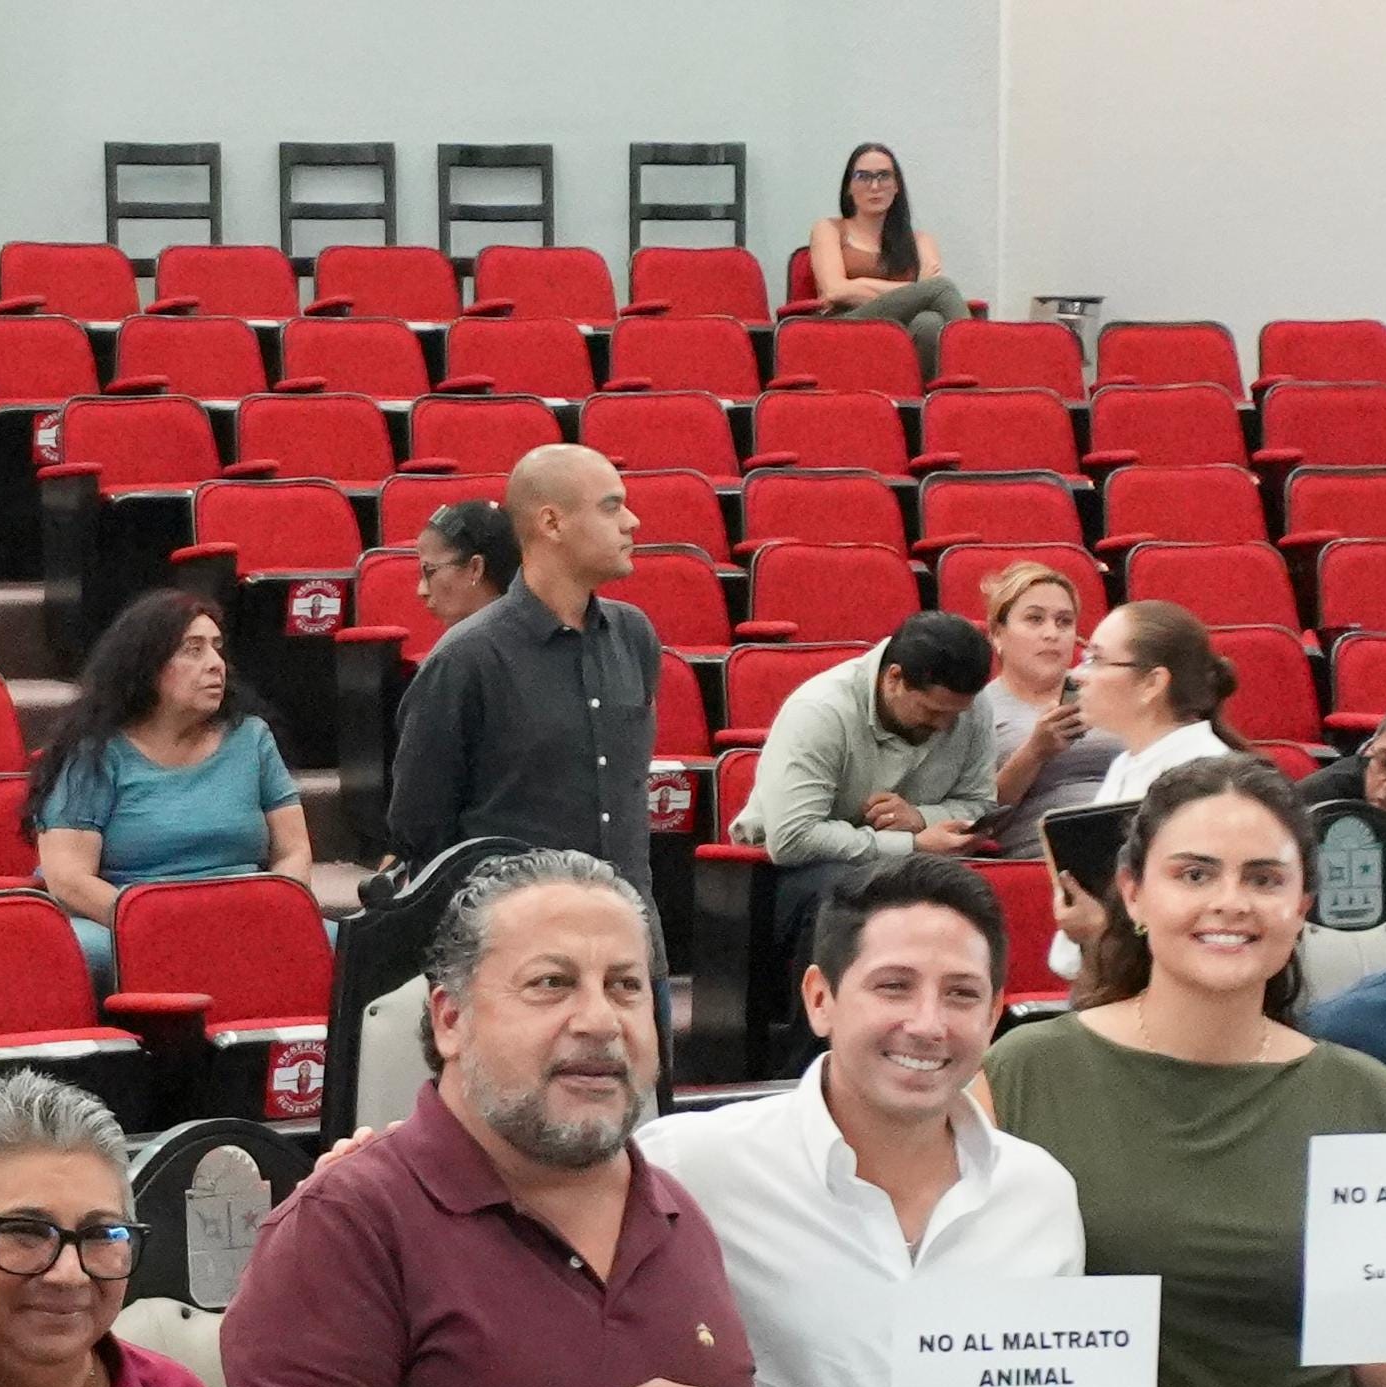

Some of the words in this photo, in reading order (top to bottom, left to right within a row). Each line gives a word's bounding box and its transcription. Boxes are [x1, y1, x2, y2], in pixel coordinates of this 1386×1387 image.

[277, 1041, 326, 1067] RESERVA
[1332, 1187, 1367, 1204] NO
[1363, 1264, 1385, 1281] Su
[919, 1334, 954, 1353] NO
[963, 1333, 994, 1351] AL
[1002, 1330, 1130, 1350] MALTRATO
[979, 1367, 1074, 1387] ANIMAL
